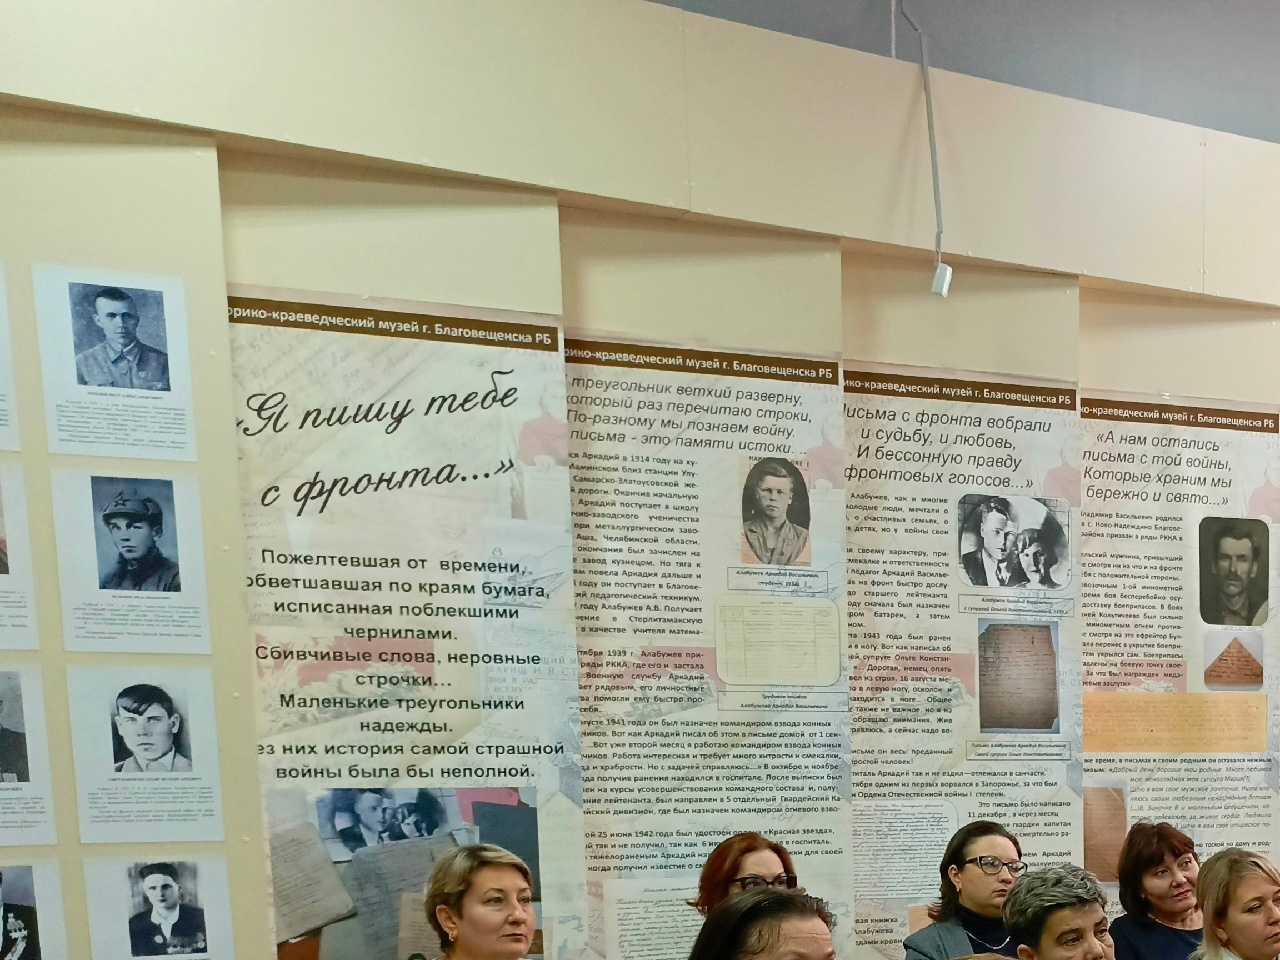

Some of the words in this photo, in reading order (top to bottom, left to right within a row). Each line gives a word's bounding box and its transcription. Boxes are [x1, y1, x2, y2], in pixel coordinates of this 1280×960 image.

[378, 320, 419, 332] музей
[422, 324, 431, 333] г.
[434, 323, 532, 342] Благовещенска
[535, 333, 551, 344] РБ
[685, 358, 719, 369] музей
[722, 361, 729, 369] г.
[733, 360, 816, 377] Благовещенска
[818, 368, 832, 378] РБ
[299, 399, 414, 434] пишу
[424, 369, 518, 415] тебе
[571, 377, 672, 394] треугольник
[676, 385, 732, 398] ветхий
[735, 390, 802, 407] разверну,
[942, 387, 972, 397] музей
[983, 388, 1056, 403] Благовещенска
[1058, 395, 1071, 404] РБ
[636, 400, 663, 412] раз
[666, 402, 752, 417] перечитаю
[756, 408, 811, 423] строки,
[901, 411, 910, 422] с
[915, 409, 982, 427] фронта
[986, 415, 1051, 433] вобрали
[1161, 412, 1187, 421] музей
[1197, 413, 1262, 427] Благовещенска
[1263, 418, 1274, 428] РБ
[566, 408, 656, 430] По-разному
[660, 419, 683, 430] мы
[687, 420, 749, 435] познаем
[752, 423, 795, 440] войну.
[570, 430, 626, 442] письма
[640, 434, 671, 446] это
[675, 437, 734, 451] памяти
[860, 428, 871, 439] и
[875, 426, 933, 447] судьбу,
[939, 433, 949, 444] и
[952, 432, 1016, 451] любовь,
[1096, 430, 1114, 443] «А
[1118, 434, 1147, 446] нам
[1151, 436, 1219, 451] остались
[581, 451, 619, 461] Аркадий
[652, 457, 671, 465] году
[857, 444, 870, 459] И
[874, 445, 963, 467] бессонную
[967, 453, 1022, 472] правду
[1082, 450, 1135, 463] письма
[1139, 453, 1147, 464] с
[1151, 455, 1182, 466] той
[1185, 455, 1231, 472] войны,
[844, 464, 944, 483] фронтовых
[948, 472, 1033, 488] голосов...»
[1083, 465, 1151, 484] Которые
[1155, 473, 1207, 487] храним
[1210, 477, 1232, 488] мы
[261, 485, 280, 506] с
[293, 460, 514, 516] фронта...»
[850, 492, 889, 501] Алабужев,
[1086, 484, 1148, 502] бережно
[1152, 491, 1161, 502] и
[1165, 492, 1228, 505] свято...»
[261, 548, 400, 568] Пожелтевшая
[407, 558, 427, 569] от
[439, 560, 525, 577] времени,
[389, 581, 412, 592] по
[418, 582, 475, 596] краям
[481, 579, 549, 599] бумага,
[274, 601, 392, 615] исписанная
[399, 602, 520, 619] поблекшими
[343, 627, 457, 642] чернилами.
[255, 645, 372, 662] Сбивчивые
[378, 651, 441, 663] слова,
[447, 653, 541, 667] неровные
[580, 661, 603, 669] ряды
[605, 660, 630, 669] РККА,
[355, 674, 451, 688] строчки...
[279, 693, 390, 709] Маленькие
[394, 698, 524, 713] треугольники
[360, 721, 453, 734] надежды.
[282, 745, 318, 754] них
[324, 744, 404, 758] история
[410, 741, 468, 755] самой
[475, 741, 564, 758] страшной
[276, 764, 341, 778] войны
[348, 764, 400, 778] была
[406, 763, 433, 778] бы
[440, 763, 534, 778] неполной.
[858, 791, 886, 800] Ордена
